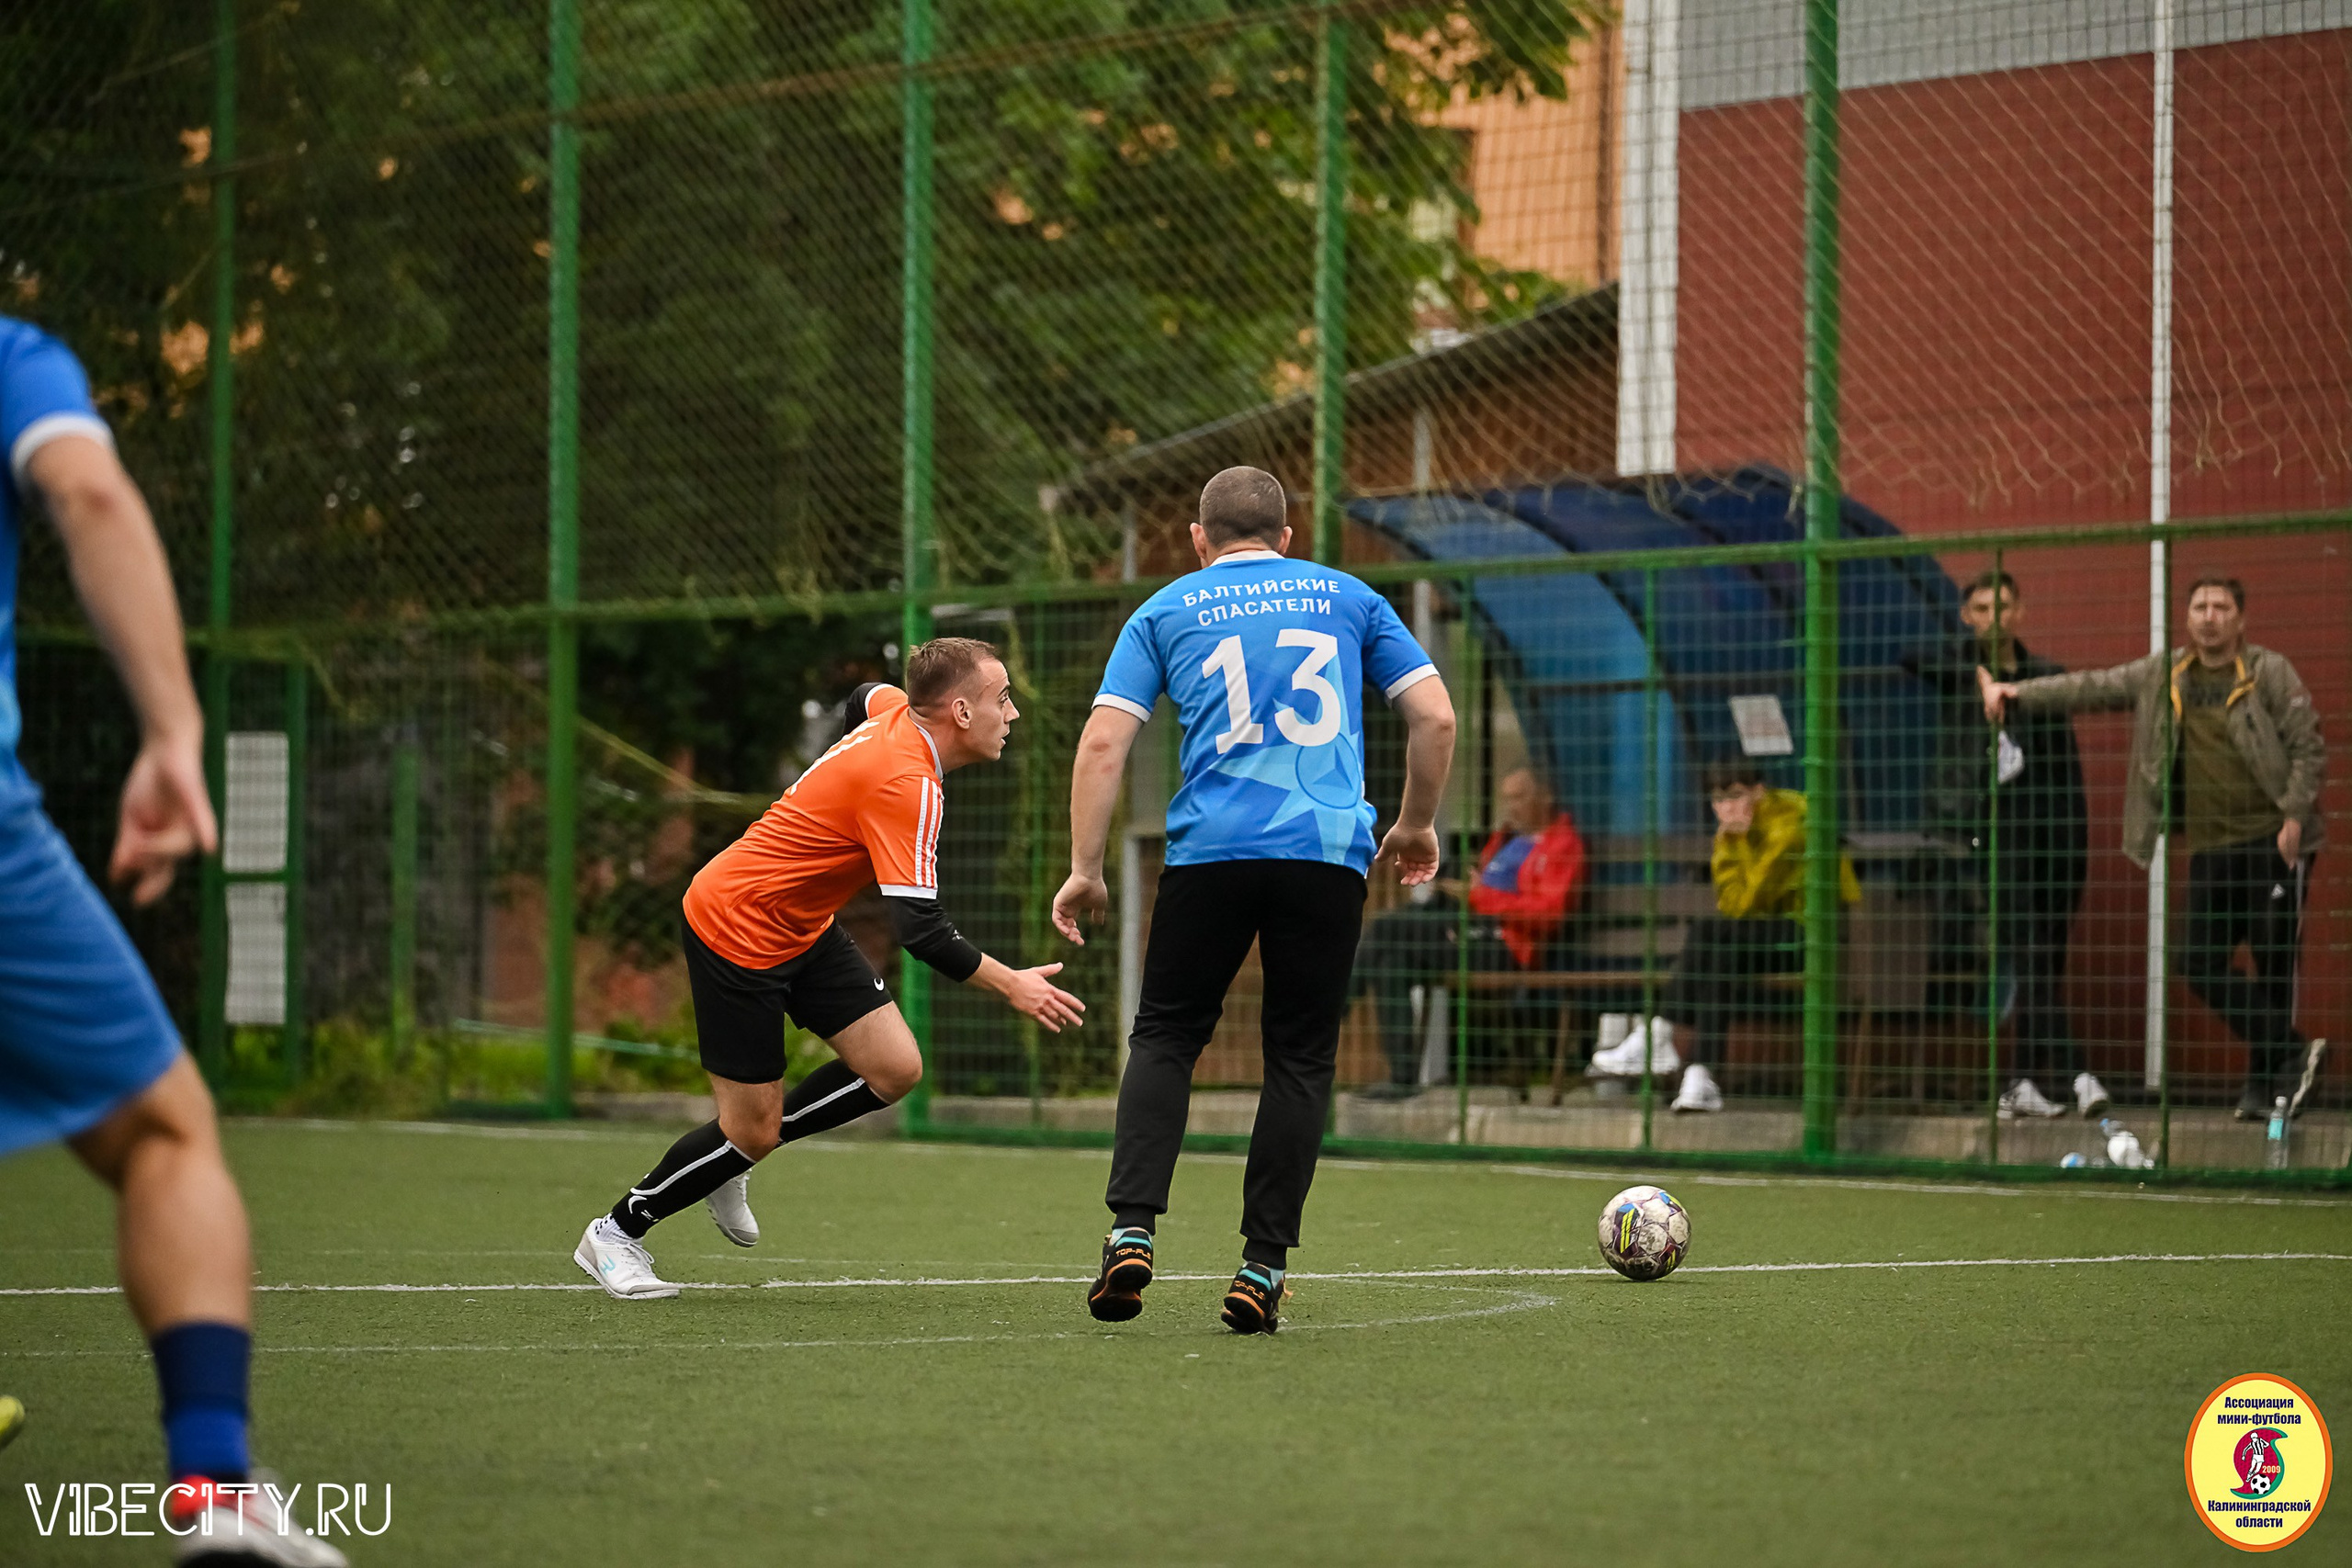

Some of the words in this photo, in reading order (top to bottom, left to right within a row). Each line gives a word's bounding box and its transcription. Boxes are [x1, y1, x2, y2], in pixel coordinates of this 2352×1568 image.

[1182, 578, 1340, 607] БАЛТИЙСКИЕ
[1197, 598, 1331, 626] СПАСАТЕЛИ
[1201, 628, 1341, 755] 13
